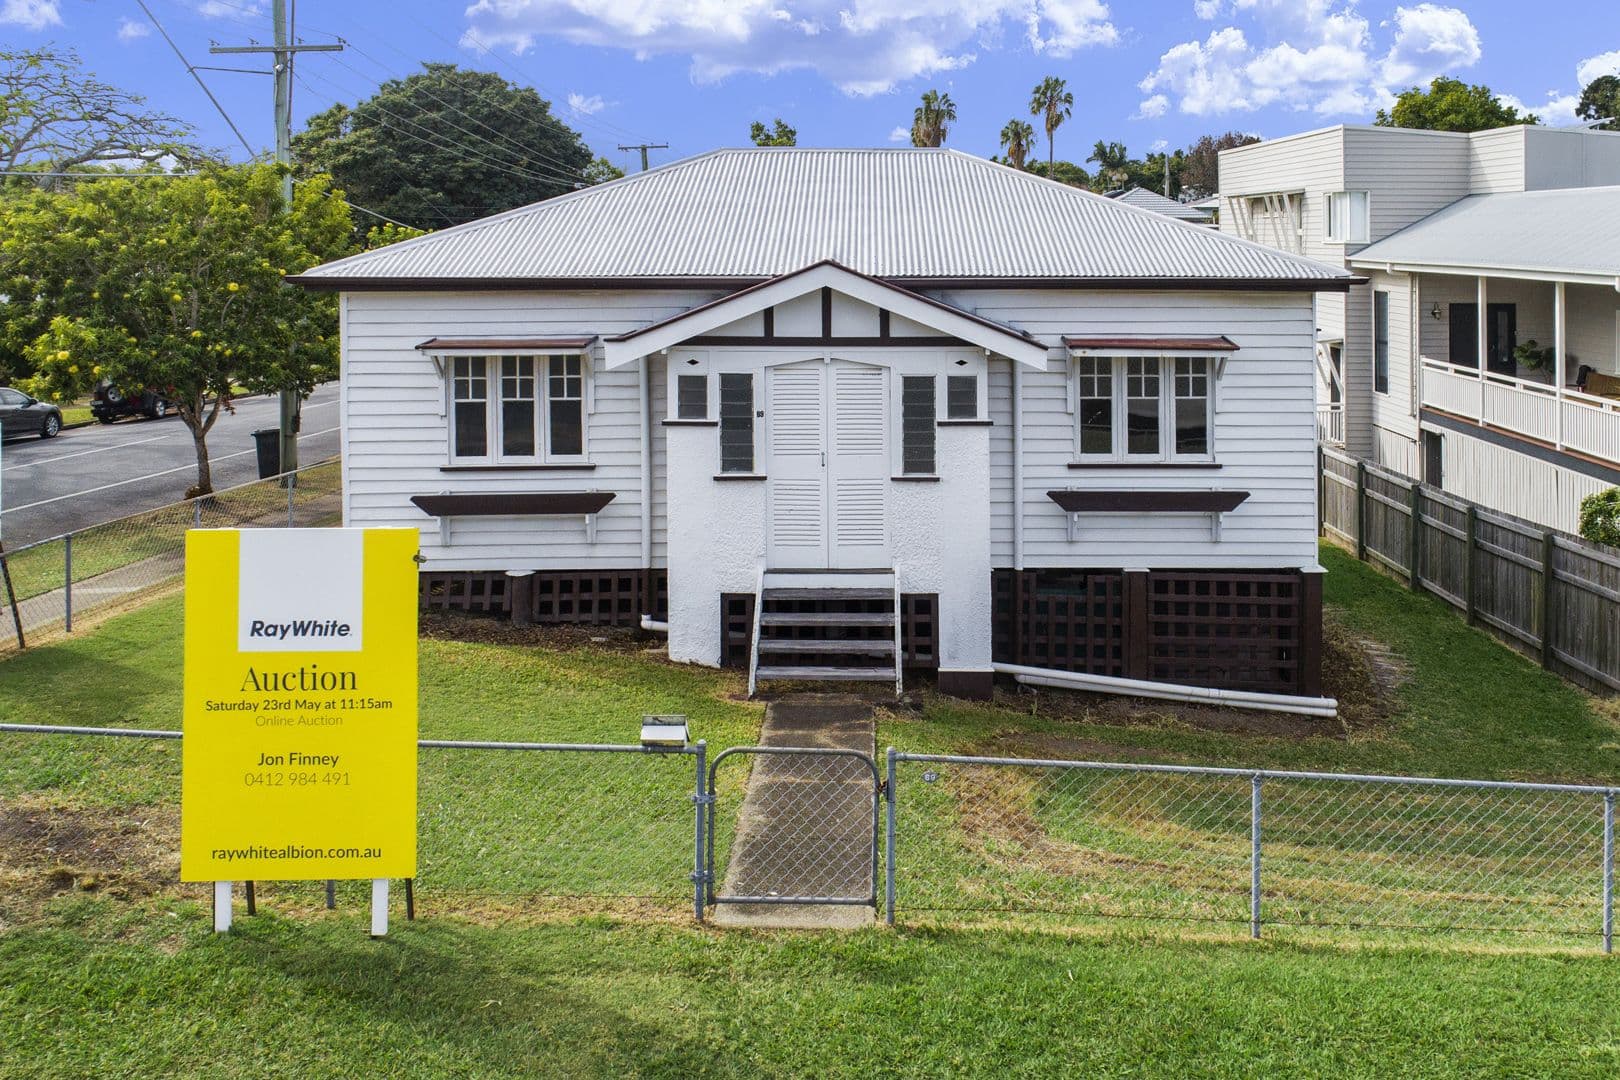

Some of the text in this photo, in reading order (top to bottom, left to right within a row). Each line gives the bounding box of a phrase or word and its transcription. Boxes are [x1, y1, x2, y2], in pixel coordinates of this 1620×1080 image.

[240, 664, 358, 692] Auction
[205, 697, 393, 712] Saturday 23rd May at 11:15am
[255, 714, 344, 727] Online Auction
[257, 752, 340, 768] Jon Finney
[244, 771, 351, 787] 0412 984 491
[211, 844, 382, 862] raywhitealbion.com.au
